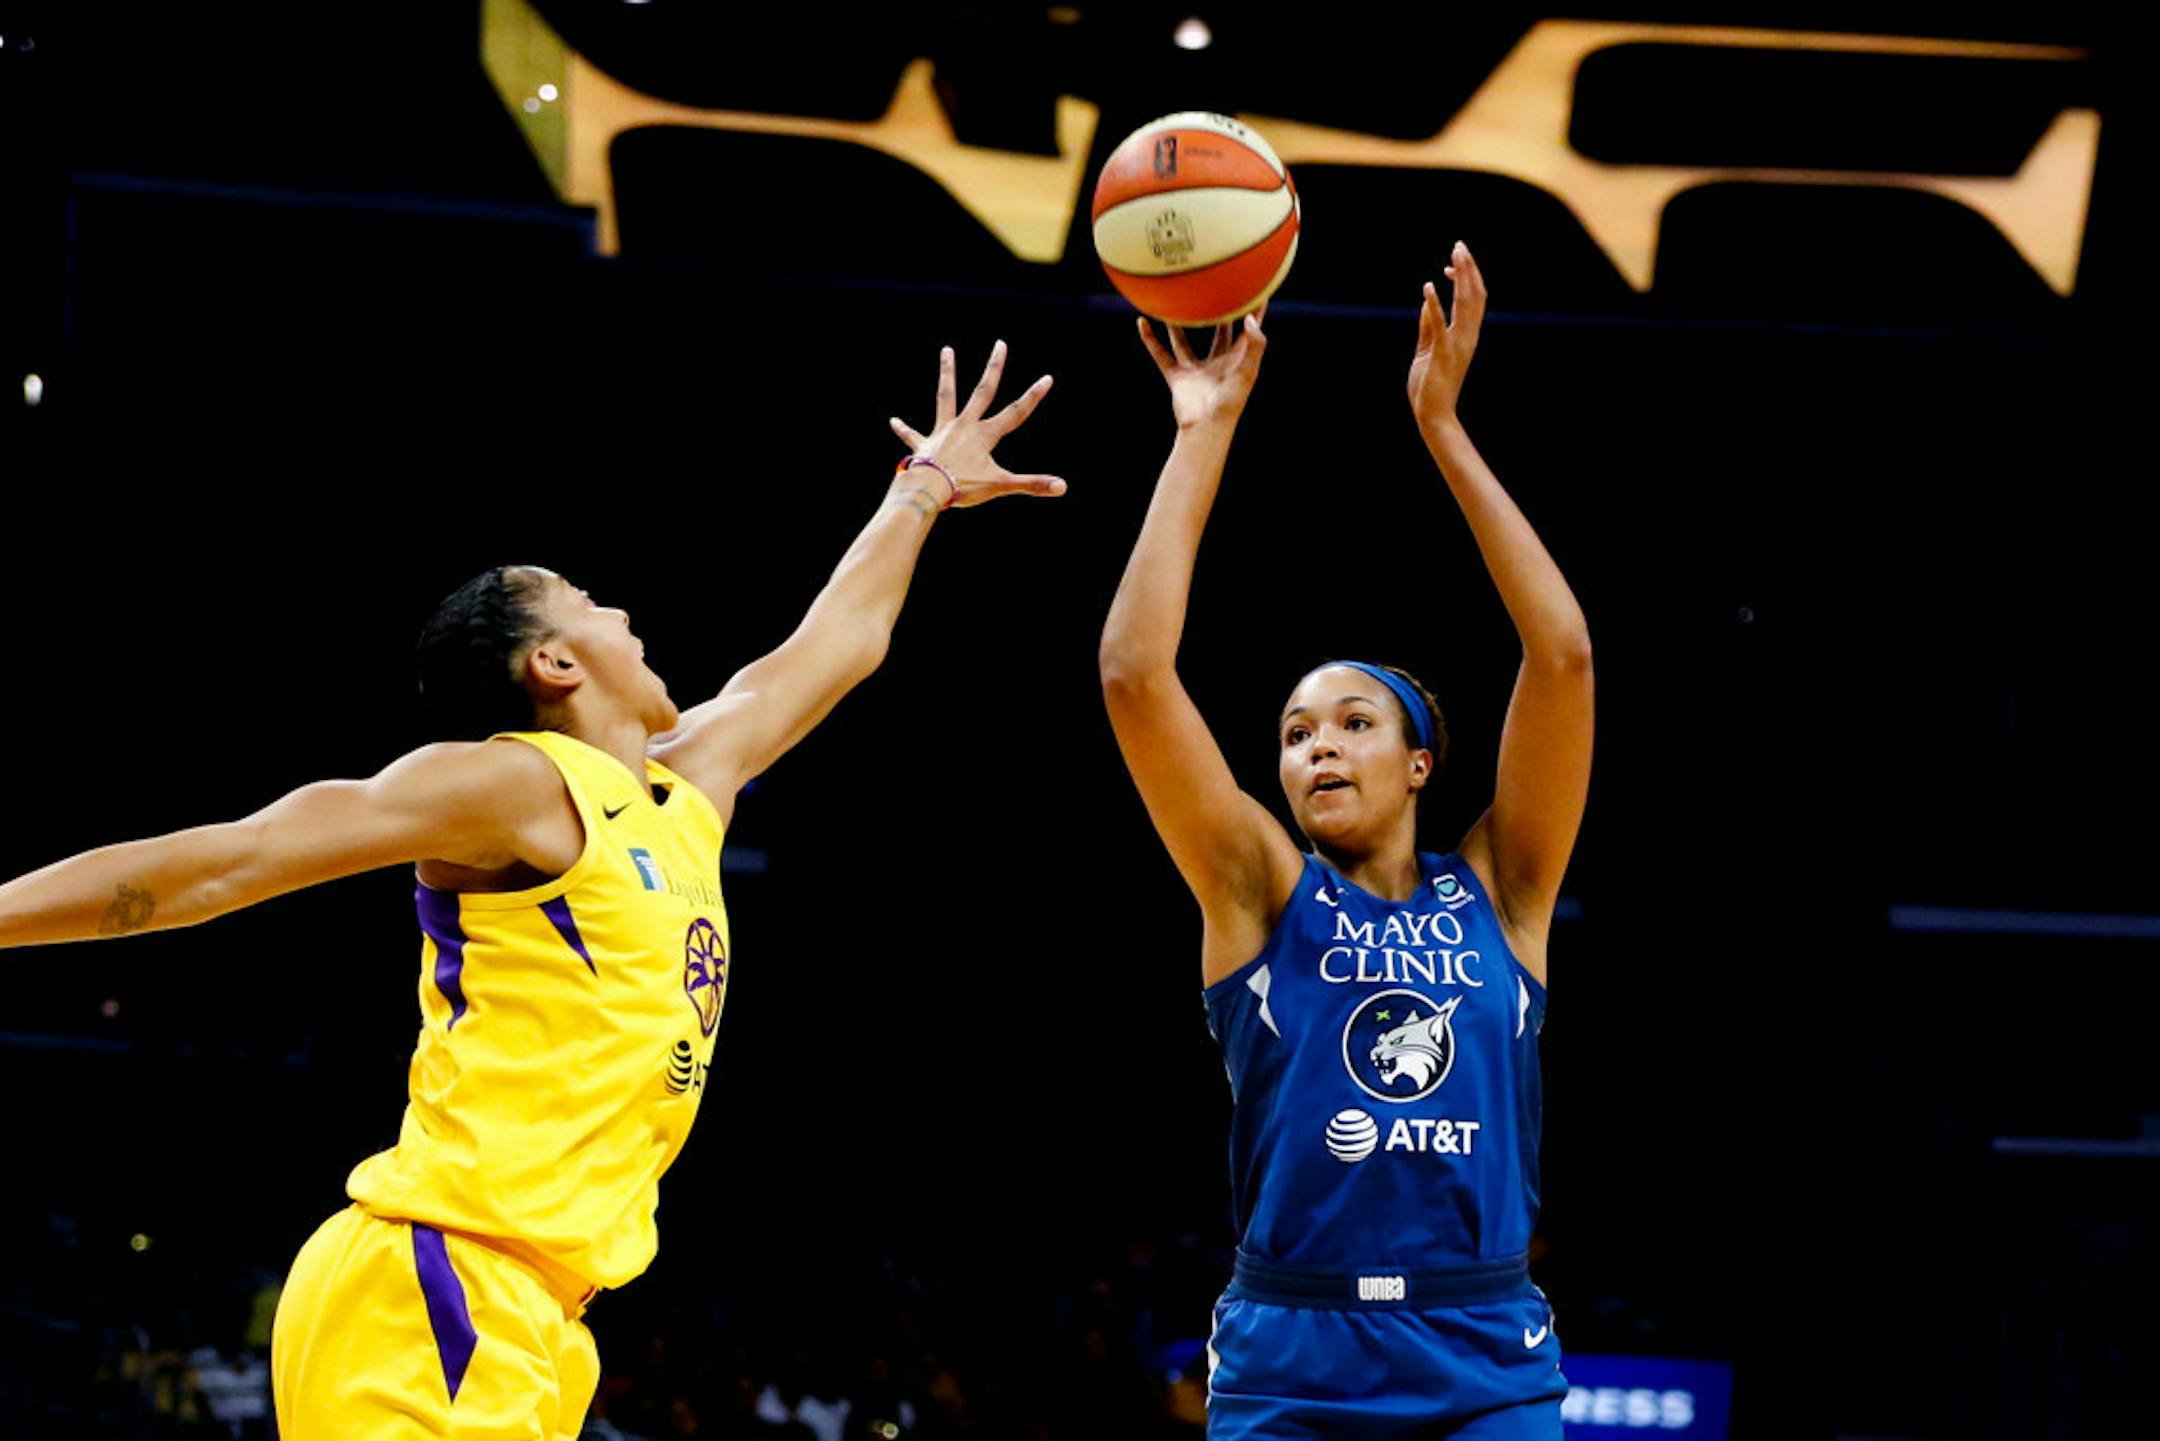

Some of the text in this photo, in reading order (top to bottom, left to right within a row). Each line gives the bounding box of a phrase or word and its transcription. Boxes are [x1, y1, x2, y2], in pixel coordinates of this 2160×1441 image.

[1332, 910, 1464, 949] MAYO
[1319, 946, 1484, 987] CLINIC
[1385, 1118, 1480, 1155] AT&T
